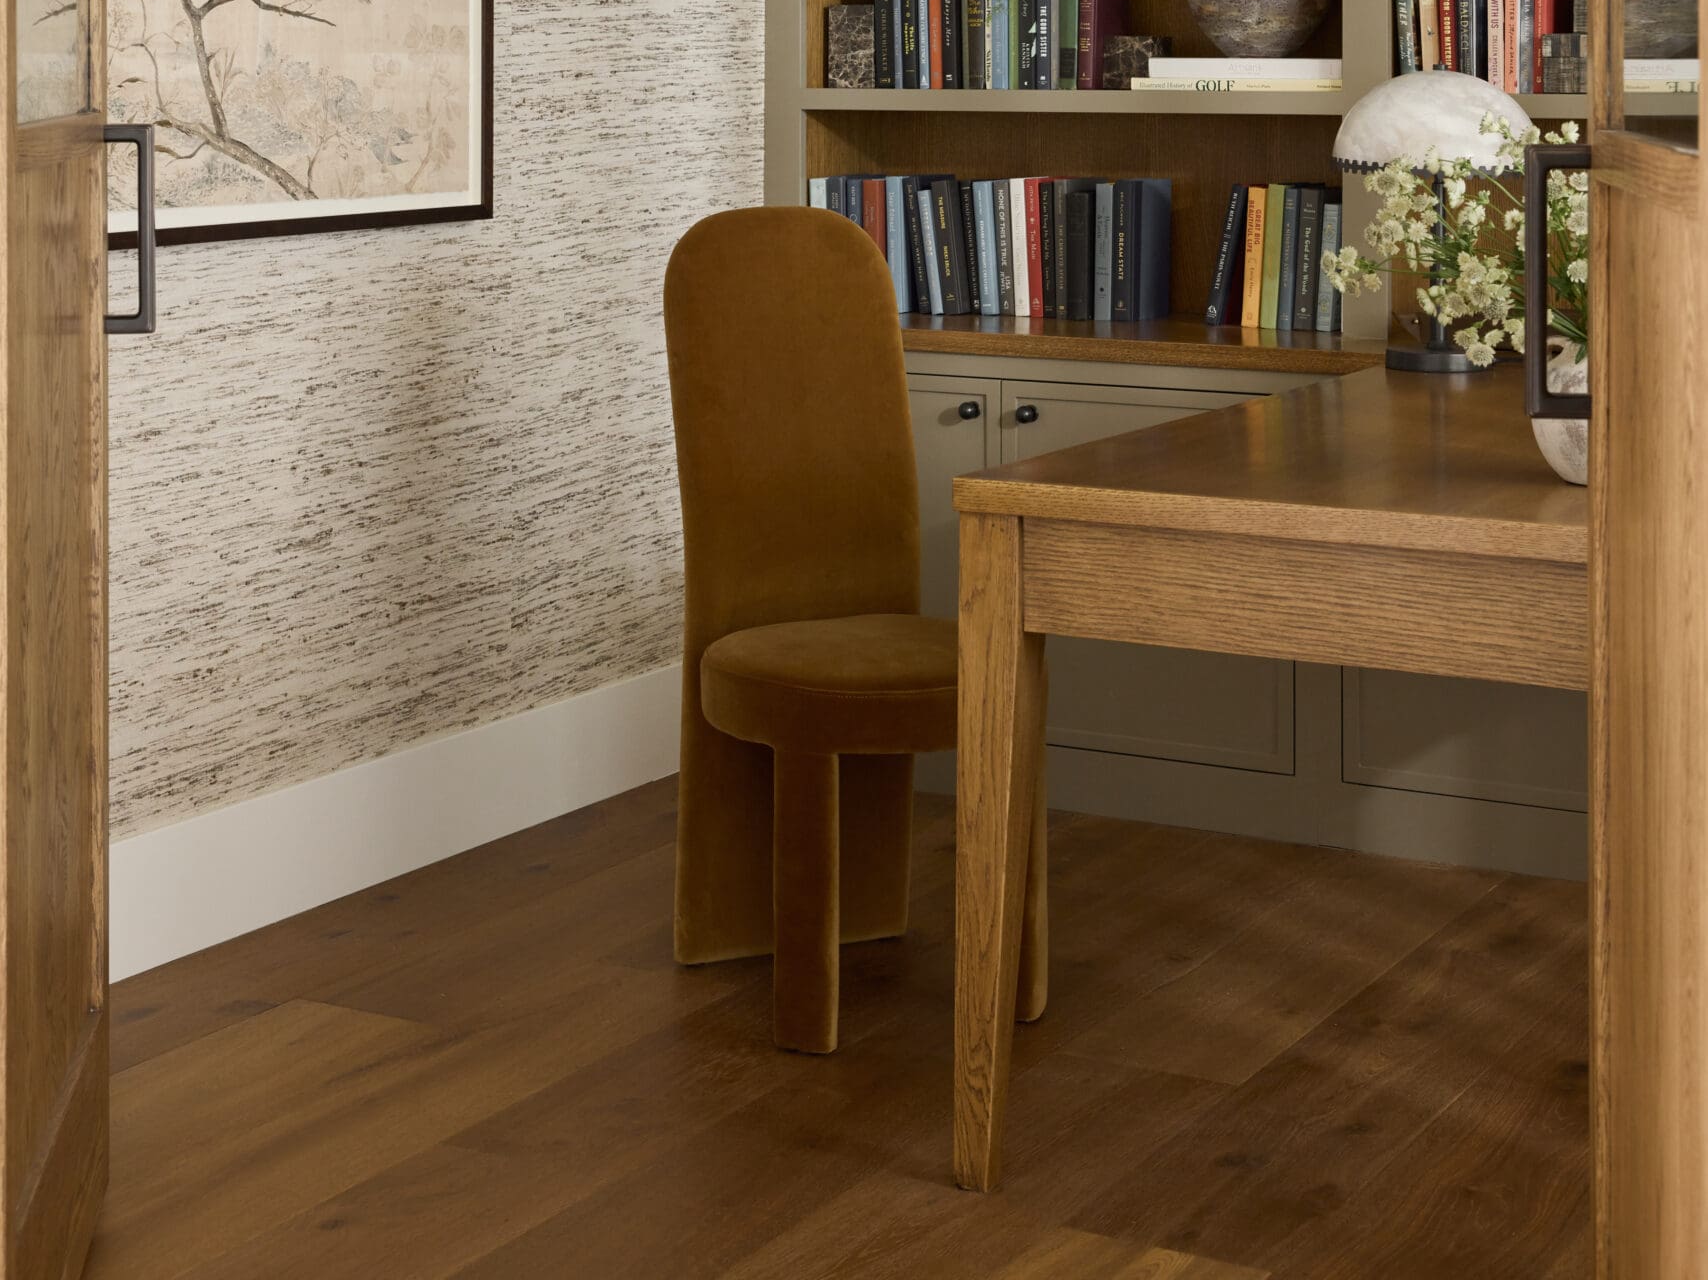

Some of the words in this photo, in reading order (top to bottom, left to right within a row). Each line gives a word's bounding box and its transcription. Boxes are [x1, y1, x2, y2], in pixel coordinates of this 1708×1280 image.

[1039, 6, 1047, 16] THE
[1491, 0, 1499, 17] WITH
[1443, 16, 1451, 35] GOOD
[1460, 1, 1469, 50] BALDACCI
[1491, 19, 1499, 29] US
[1195, 79, 1236, 92] GOLF
[998, 189, 1006, 211] NONE
[999, 211, 1006, 222] OF
[1247, 200, 1255, 237] BEAUTIFUL
